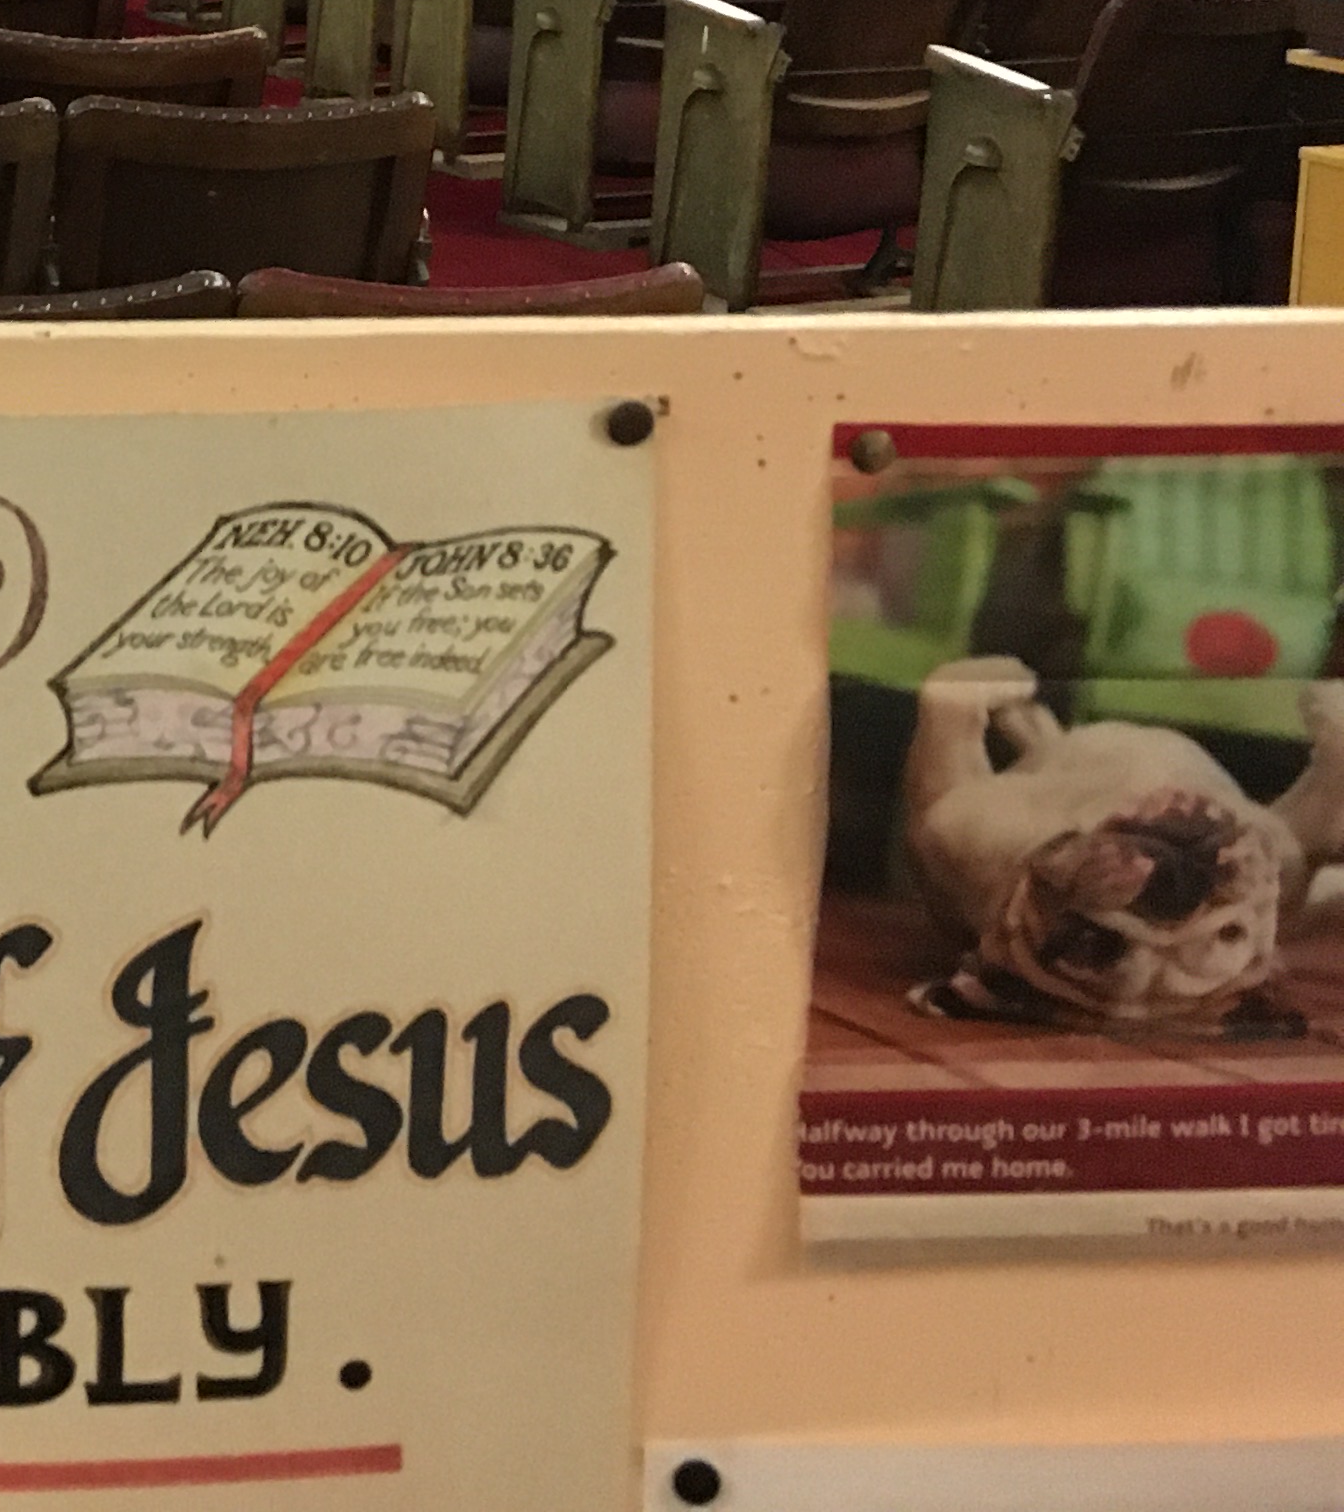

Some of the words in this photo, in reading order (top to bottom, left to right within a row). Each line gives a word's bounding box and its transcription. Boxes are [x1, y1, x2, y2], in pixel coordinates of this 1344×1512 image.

[304, 520, 373, 568] 8:10
[395, 541, 499, 580] JOHN
[497, 541, 574, 573] 8:36
[185, 555, 243, 586] The
[235, 557, 297, 594] joy
[299, 568, 341, 592] of
[396, 581, 442, 607] the
[444, 575, 492, 602] Son
[496, 579, 545, 603] sets
[150, 590, 198, 620] the
[198, 590, 275, 620] Lord
[265, 596, 294, 628] is
[101, 630, 176, 659] your
[338, 620, 402, 649] you
[462, 615, 517, 642] you
[298, 651, 348, 676] are
[354, 638, 406, 669] free
[408, 642, 492, 675] indeed
[56, 918, 614, 1226] Jesus
[906, 1118, 1014, 1150] through
[1022, 1122, 1066, 1142] our
[1078, 1113, 1162, 1141] 3-mile
[1171, 1112, 1232, 1138] walk
[1258, 1114, 1302, 1146] got
[792, 1157, 835, 1181] ou
[842, 1155, 933, 1180] carried
[942, 1160, 984, 1180] me
